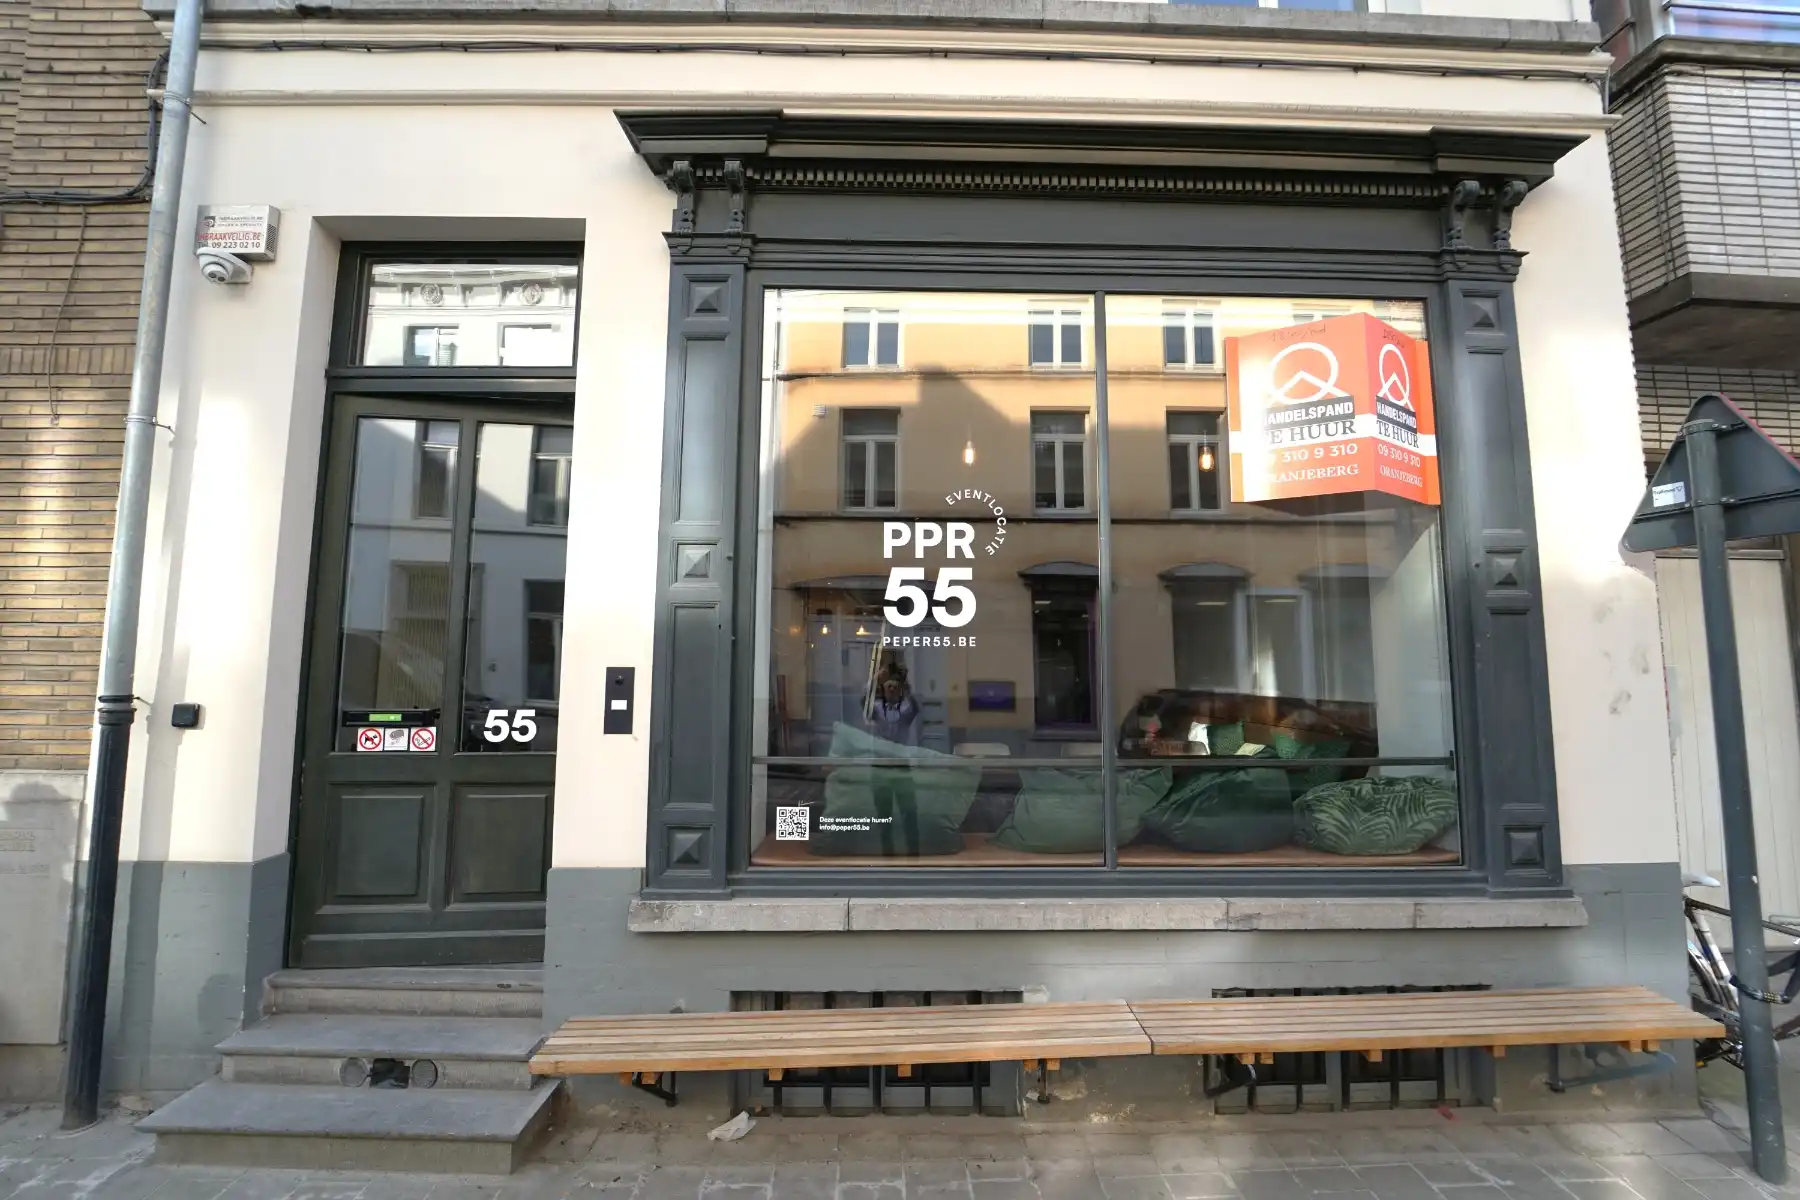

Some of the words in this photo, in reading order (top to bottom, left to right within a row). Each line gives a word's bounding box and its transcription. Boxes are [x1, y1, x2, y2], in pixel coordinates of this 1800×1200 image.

[212, 241, 221, 249] 09
[223, 241, 238, 249] 223
[239, 241, 249, 249] 02
[251, 241, 260, 249] 10
[1376, 401, 1417, 429] HANDELSPAND
[1290, 420, 1357, 442] HUUR
[1376, 420, 1390, 438] TE
[1392, 425, 1419, 448] HUUR
[1282, 449, 1309, 463] 310
[1314, 447, 1325, 459] 9
[1329, 443, 1358, 457] 310
[1377, 443, 1388, 456] 09
[1390, 447, 1402, 461] 310
[1410, 454, 1420, 468] 310
[1380, 464, 1423, 487] ORANJEBERG
[945, 489, 1007, 556] EVENTLOCATIE
[883, 521, 975, 558] PPR
[883, 567, 976, 628] 55
[883, 636, 976, 647] PEPER55.BE
[483, 709, 537, 743] 55
[819, 823, 870, 832] info@peper55.be
